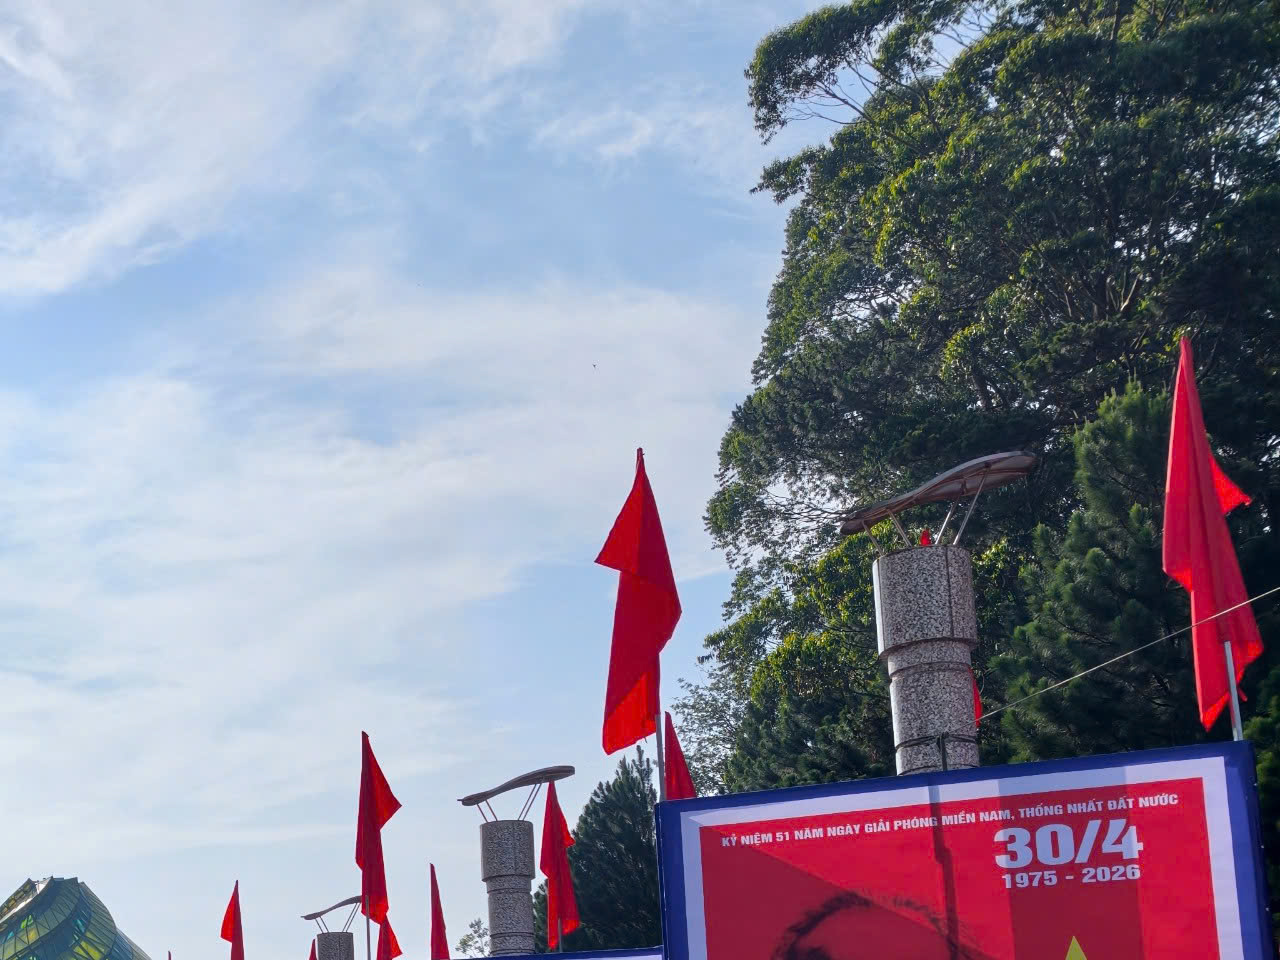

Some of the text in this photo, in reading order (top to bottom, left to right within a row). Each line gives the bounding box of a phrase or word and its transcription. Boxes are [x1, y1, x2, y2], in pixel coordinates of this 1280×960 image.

[722, 792, 1179, 847] KỶ NIỆM 51 NĂM NGÀY GIẢI PHÓNG MIỀN NAM, THỐNG NHẤT ĐẤT NƯỚC
[993, 819, 1144, 869] 30/4
[1001, 864, 1141, 889] 1975 2026
